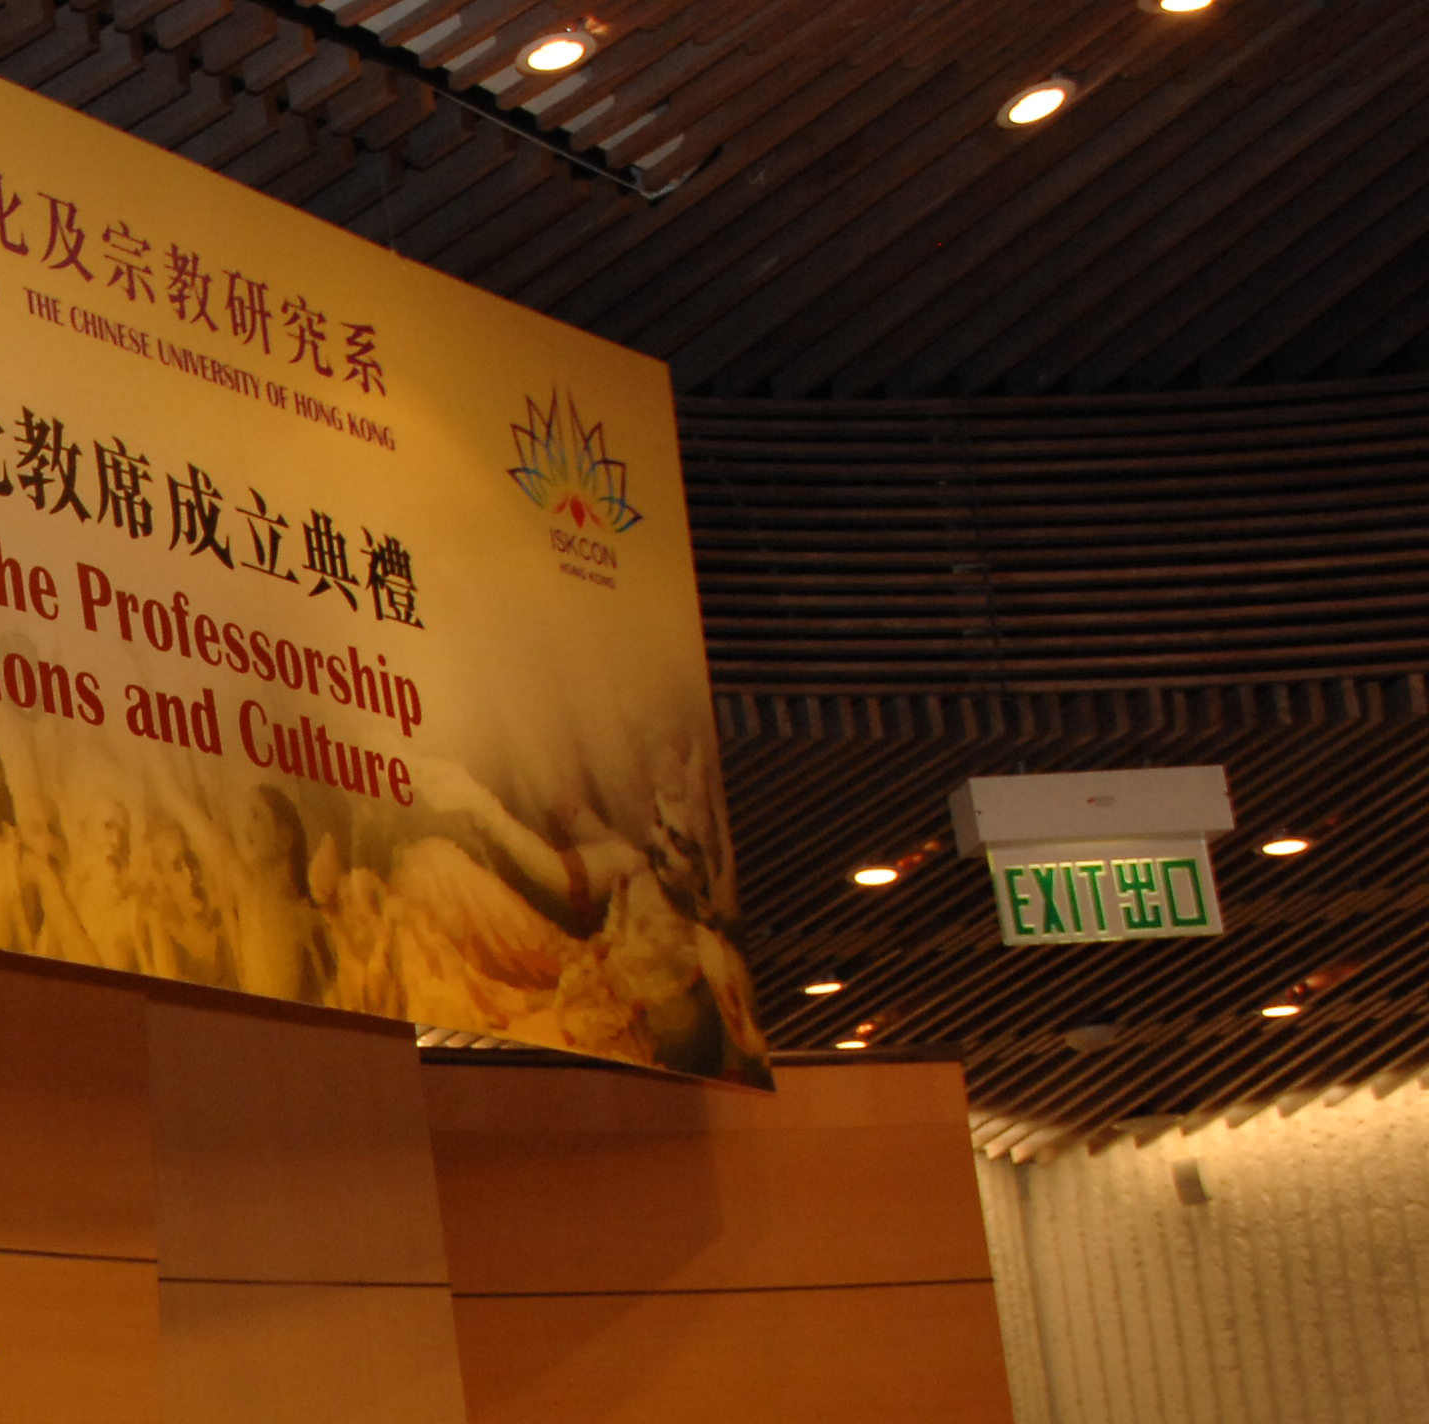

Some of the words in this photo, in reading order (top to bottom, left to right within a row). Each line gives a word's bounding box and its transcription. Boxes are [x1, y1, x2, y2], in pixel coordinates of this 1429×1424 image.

[23, 287, 64, 326] THE
[70, 307, 151, 359] CHINESE
[157, 338, 261, 399] UNIVERSITY
[266, 381, 288, 409] OF
[294, 392, 343, 432] HONG
[347, 411, 395, 451] KONG
[549, 528, 618, 570] ISKCON
[75, 561, 422, 737] Professorship
[125, 683, 223, 757] and
[238, 699, 414, 808] Culture
[1004, 864, 1107, 936] EXIT
[1114, 858, 1208, 930] 出口
